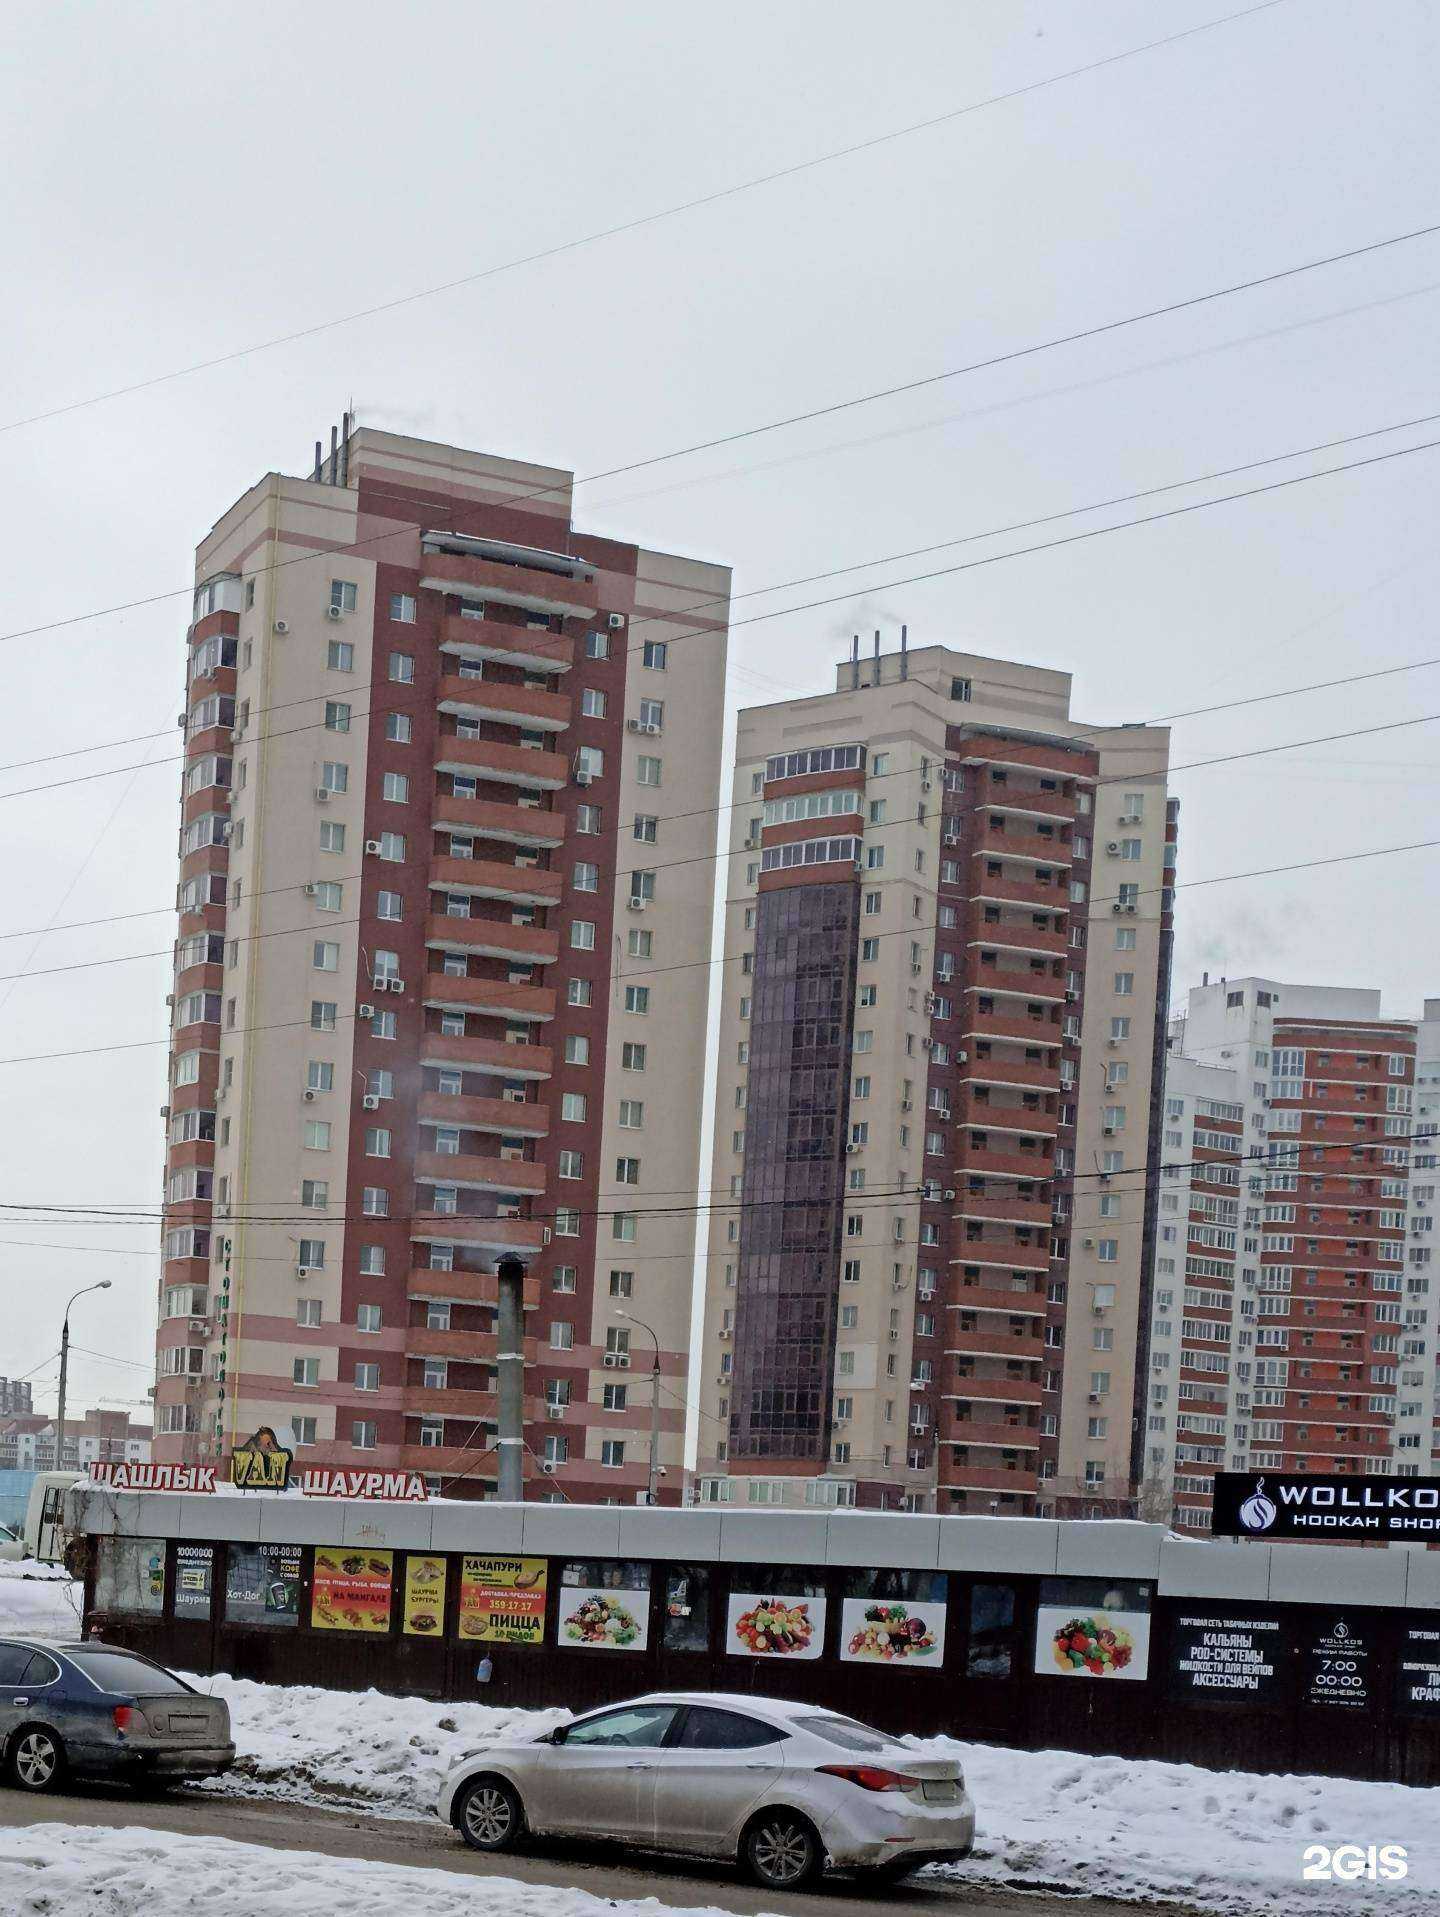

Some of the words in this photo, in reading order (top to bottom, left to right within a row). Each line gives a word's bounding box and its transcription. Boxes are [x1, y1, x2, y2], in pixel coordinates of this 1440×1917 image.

[90, 1463, 214, 1491] ШАШЛЫК
[304, 1470, 425, 1499] ШАУРМА
[1293, 1514, 1379, 1528] HOOKAH
[465, 1560, 523, 1573] ХАЧАПУРИ
[227, 1588, 261, 1600] Хот-Дог
[489, 1613, 540, 1631] ПИЦЦА
[1203, 1633, 1252, 1648] КАЛЬЯНЫ
[1180, 1660, 1223, 1673] ЖИДКОСТИ
[1224, 1662, 1241, 1674] ДЛЯ
[1321, 1660, 1357, 1672] 7:00
[1192, 1672, 1259, 1690] АКСЕССУАРЫ
[1315, 1675, 1362, 1687] 00:00
